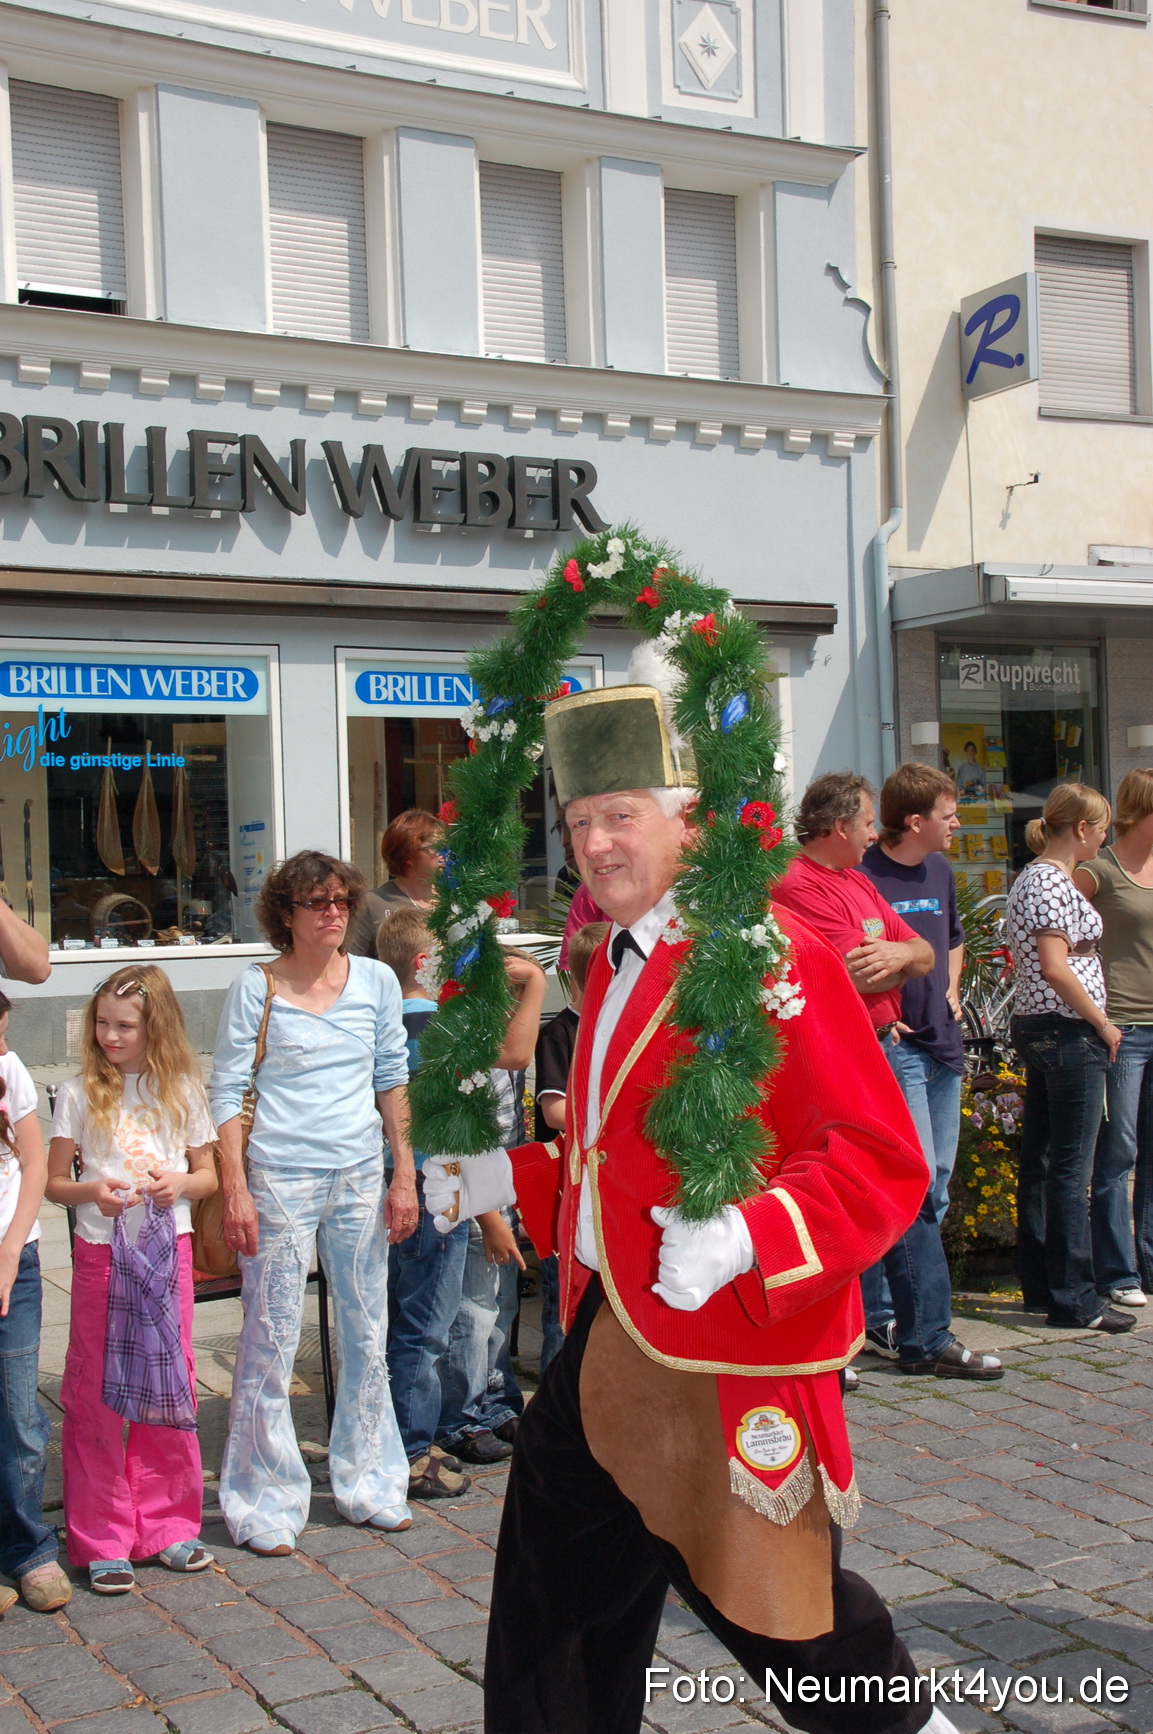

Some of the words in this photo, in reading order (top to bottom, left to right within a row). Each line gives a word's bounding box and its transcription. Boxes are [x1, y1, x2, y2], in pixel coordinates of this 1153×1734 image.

[321, 439, 612, 534] WEBER
[9, 664, 131, 696] BRILLEN
[139, 668, 249, 699] WEBER
[369, 674, 474, 703] BRILLEN
[986, 659, 1080, 691] Rupprecht
[1029, 682, 1081, 693] Buchhandlung
[0, 703, 72, 773] ight
[40, 752, 65, 767] die
[70, 752, 142, 771] günstige
[146, 752, 186, 767] Linie
[745, 1434, 793, 1449] Lammsbräu
